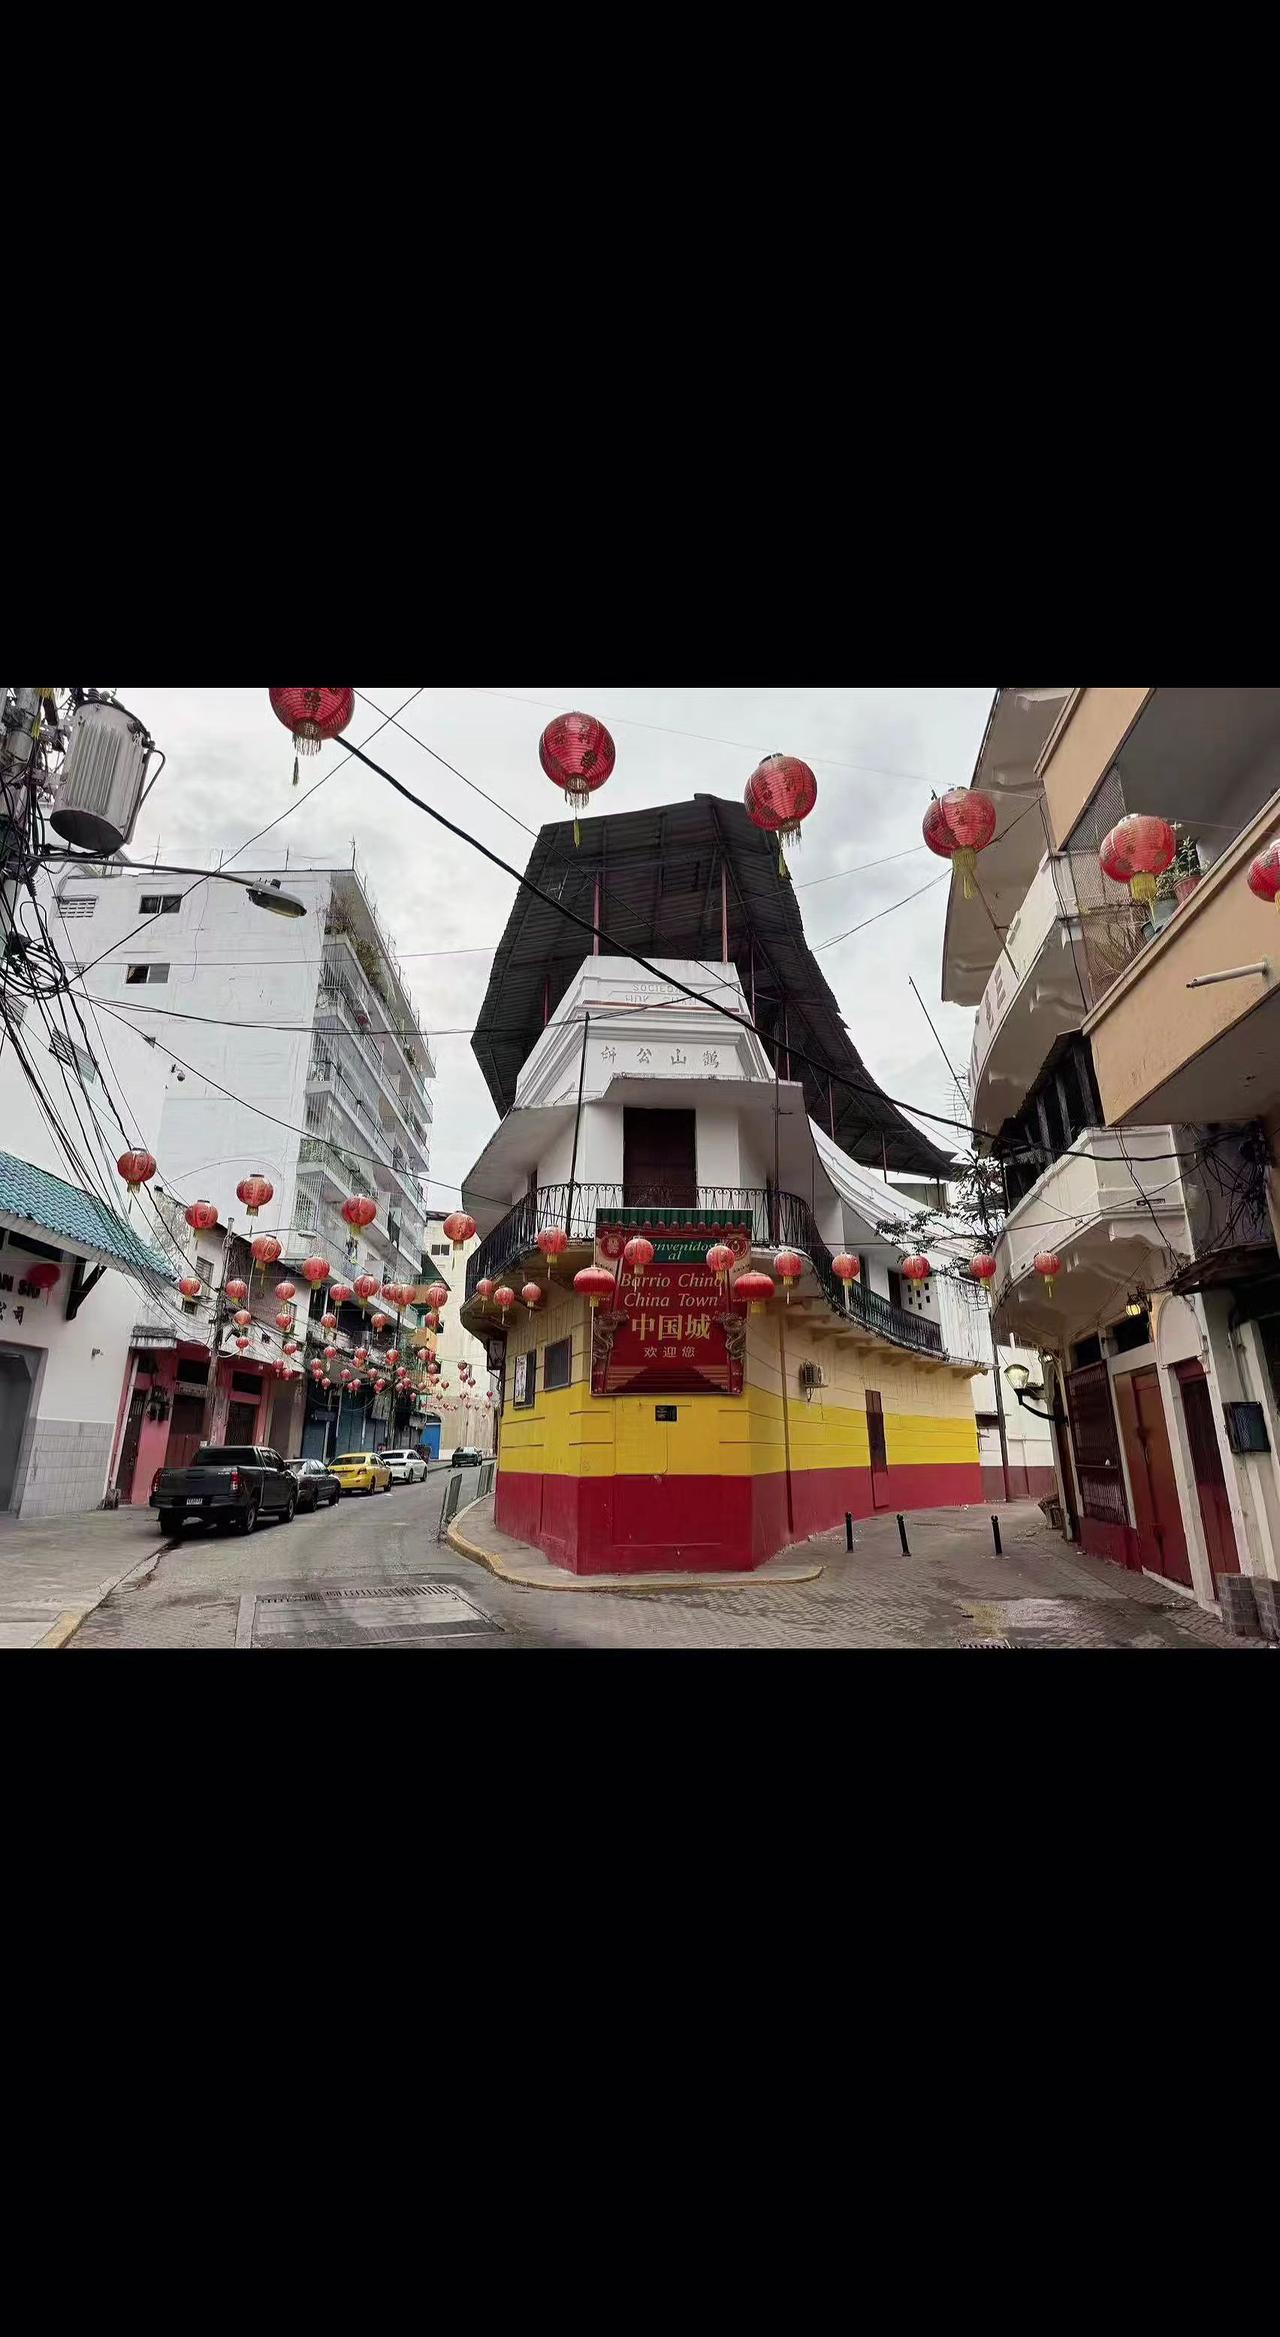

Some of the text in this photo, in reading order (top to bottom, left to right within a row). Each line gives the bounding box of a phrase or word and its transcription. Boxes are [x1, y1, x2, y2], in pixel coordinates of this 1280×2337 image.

[632, 984, 684, 993] SOCIEDA
[652, 1241, 717, 1251] envenidos
[668, 1251, 681, 1260] al
[620, 1273, 671, 1287] Barrio
[624, 1292, 718, 1307] China Town
[632, 1313, 711, 1341] 中国城
[643, 1345, 696, 1358] 欢迎您
